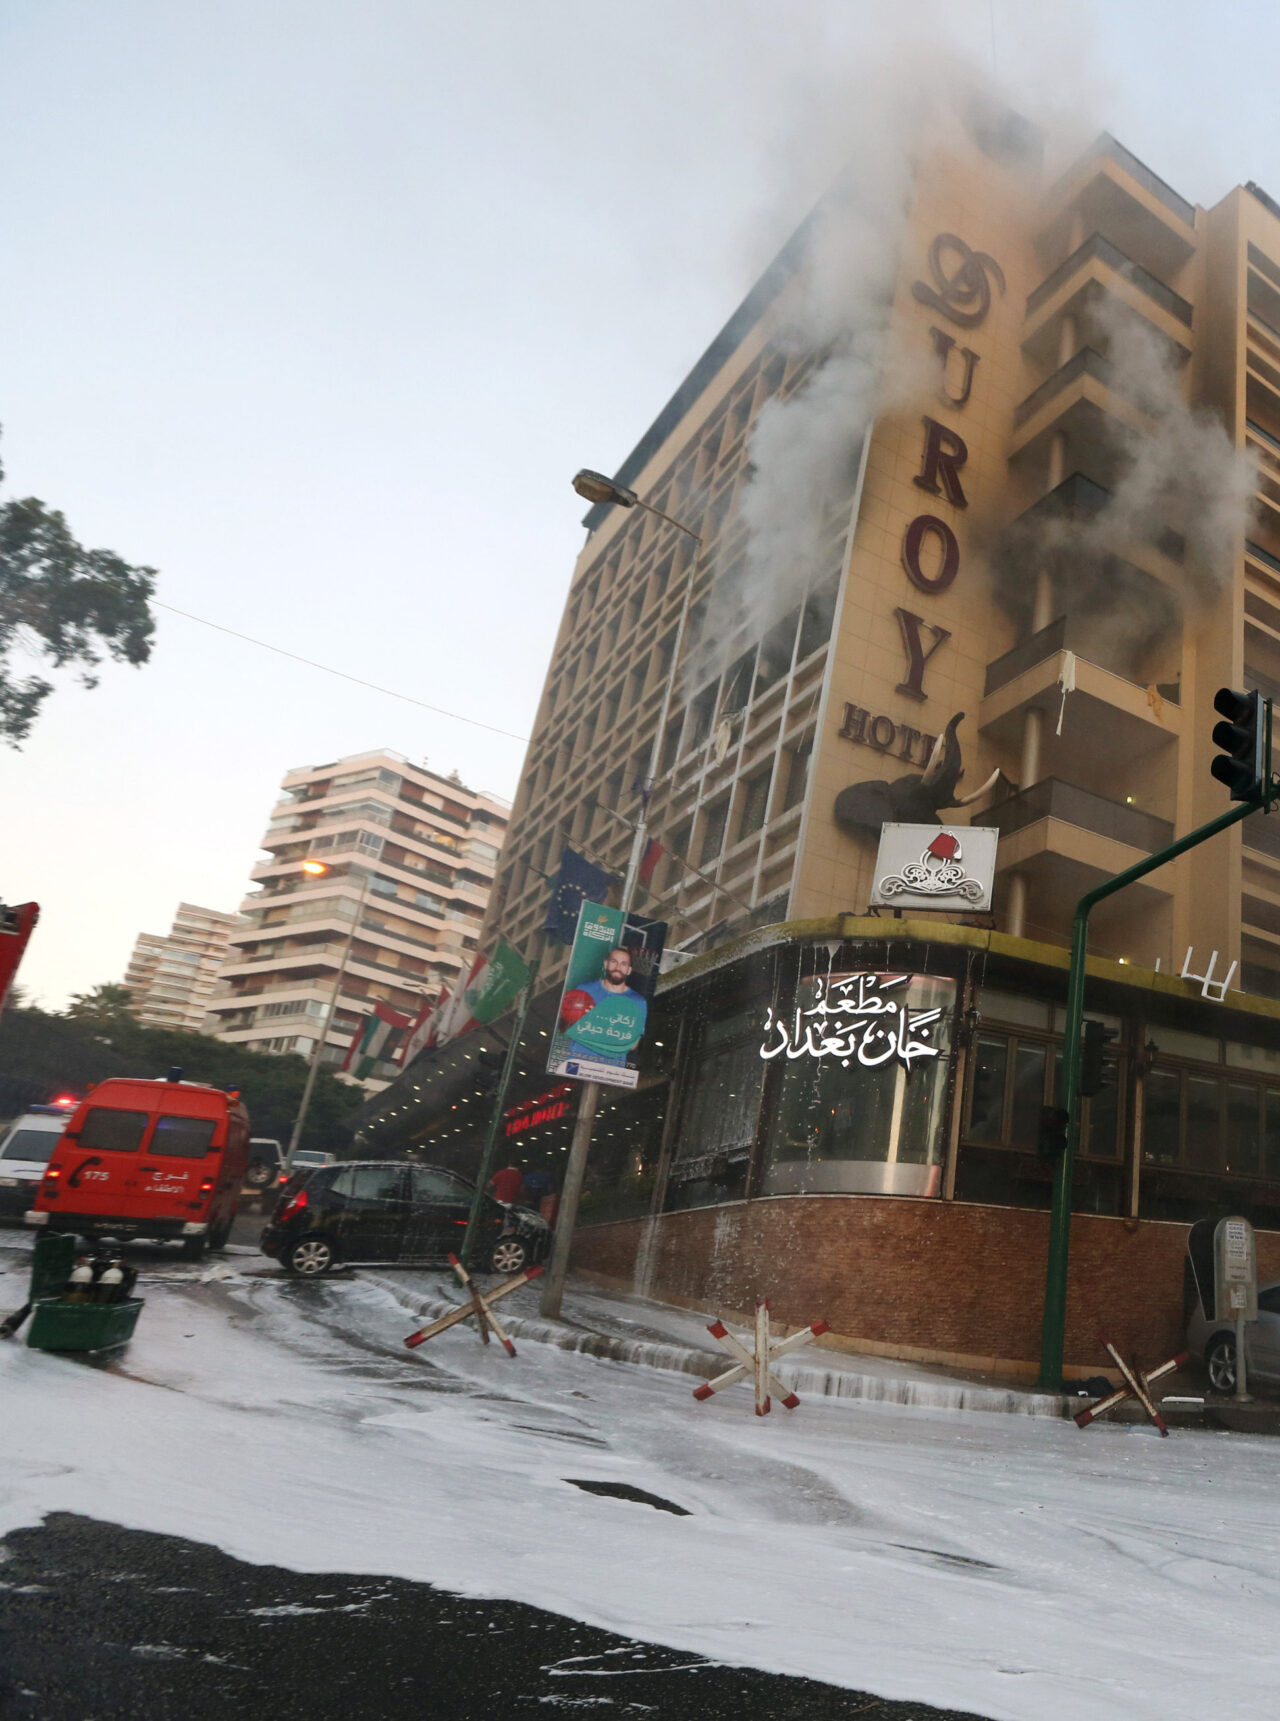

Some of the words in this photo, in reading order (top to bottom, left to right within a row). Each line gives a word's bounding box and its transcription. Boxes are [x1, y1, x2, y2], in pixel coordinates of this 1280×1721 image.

[896, 232, 1006, 701] DUROY
[838, 702, 946, 771] HOTE
[804, 974, 913, 1016] مطعم
[577, 1021, 603, 1034] حياتي
[606, 1026, 632, 1040] فرحة
[759, 1007, 867, 1068] بغداد
[858, 1005, 942, 1069] خان
[84, 1171, 110, 1181] 175
